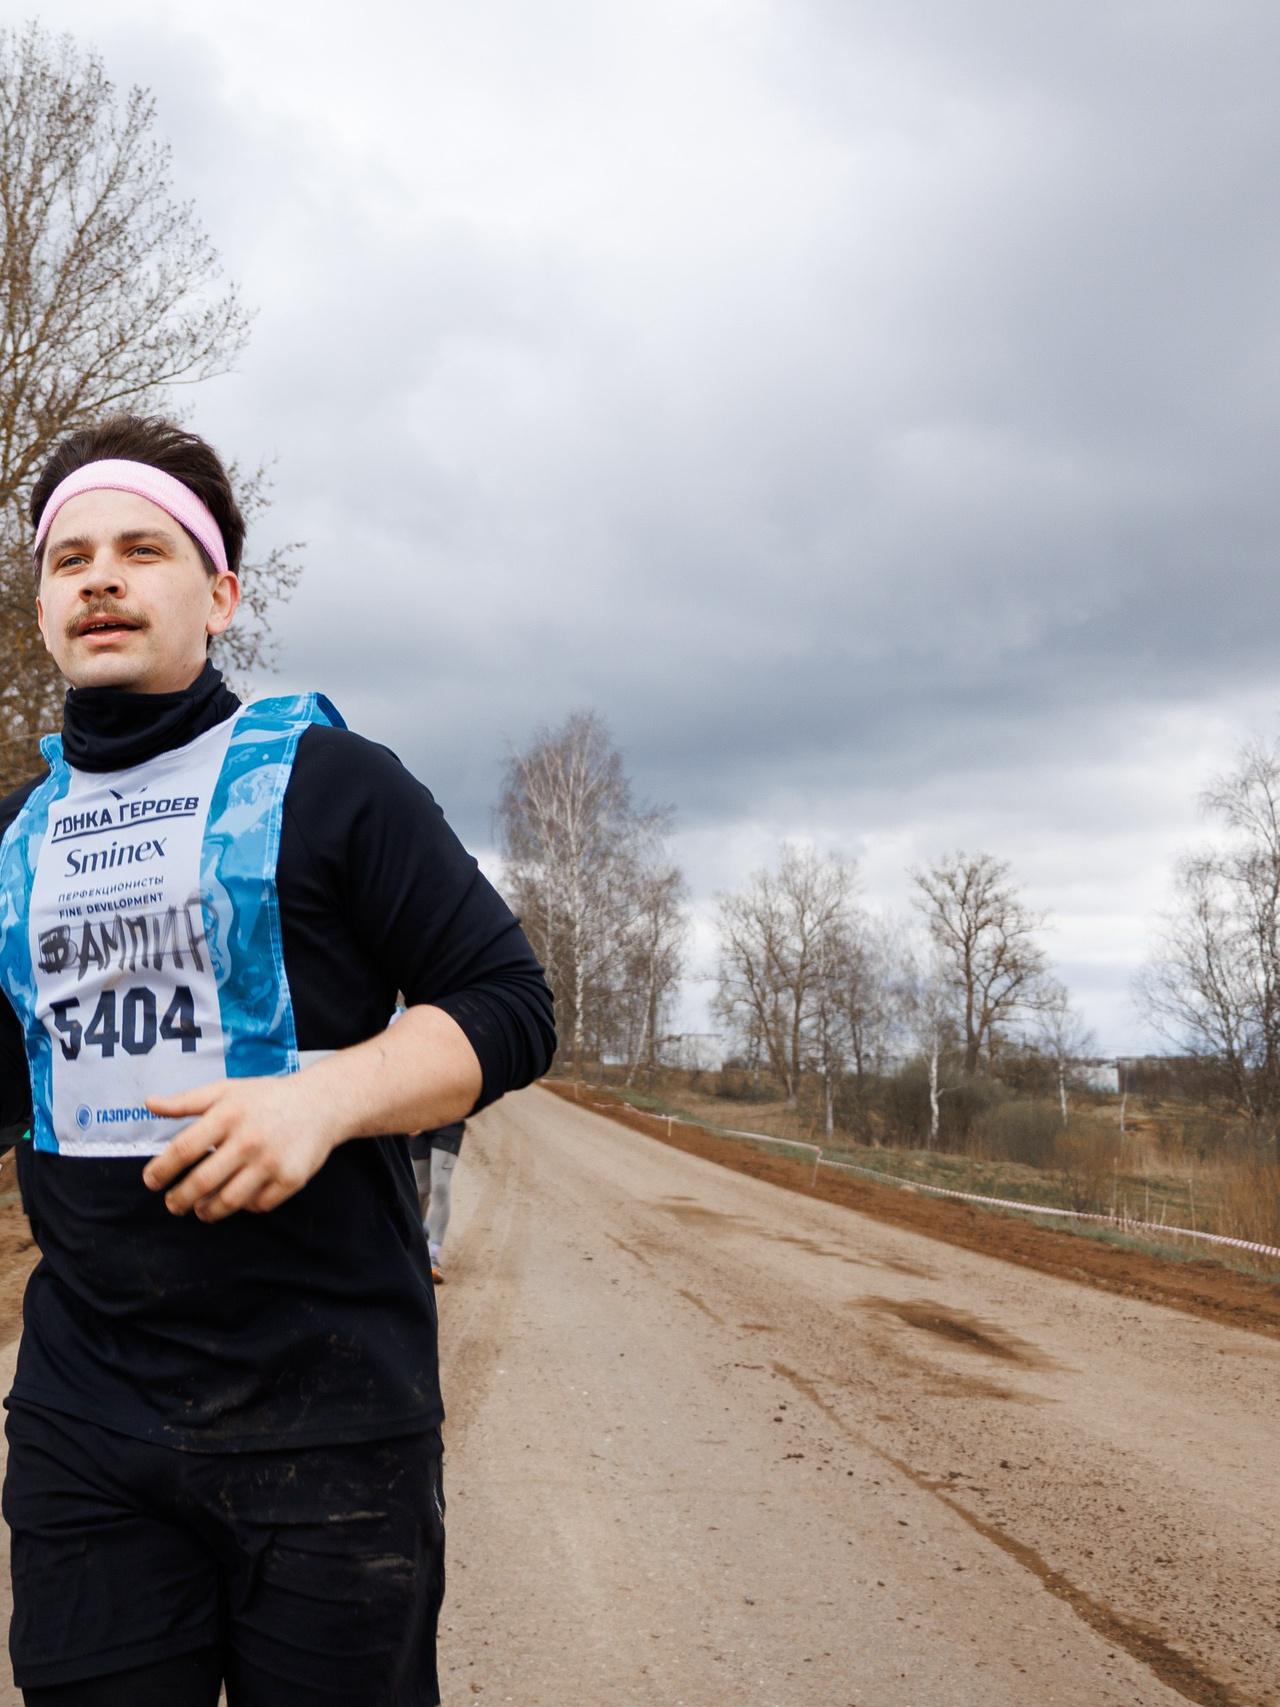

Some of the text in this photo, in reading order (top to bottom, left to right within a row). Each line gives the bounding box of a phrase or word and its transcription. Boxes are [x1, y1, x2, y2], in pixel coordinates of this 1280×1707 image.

[53, 797, 200, 838] ГОНКА ГЕРОЕВ
[64, 837, 168, 878] Sminex
[58, 875, 164, 903] ПЕРФЕКЦИОНИСТЫ
[59, 892, 164, 919] FINE DEVELOPMENT
[49, 985, 203, 1061] 5404
[96, 1107, 170, 1124] ГАЗПРОМ
